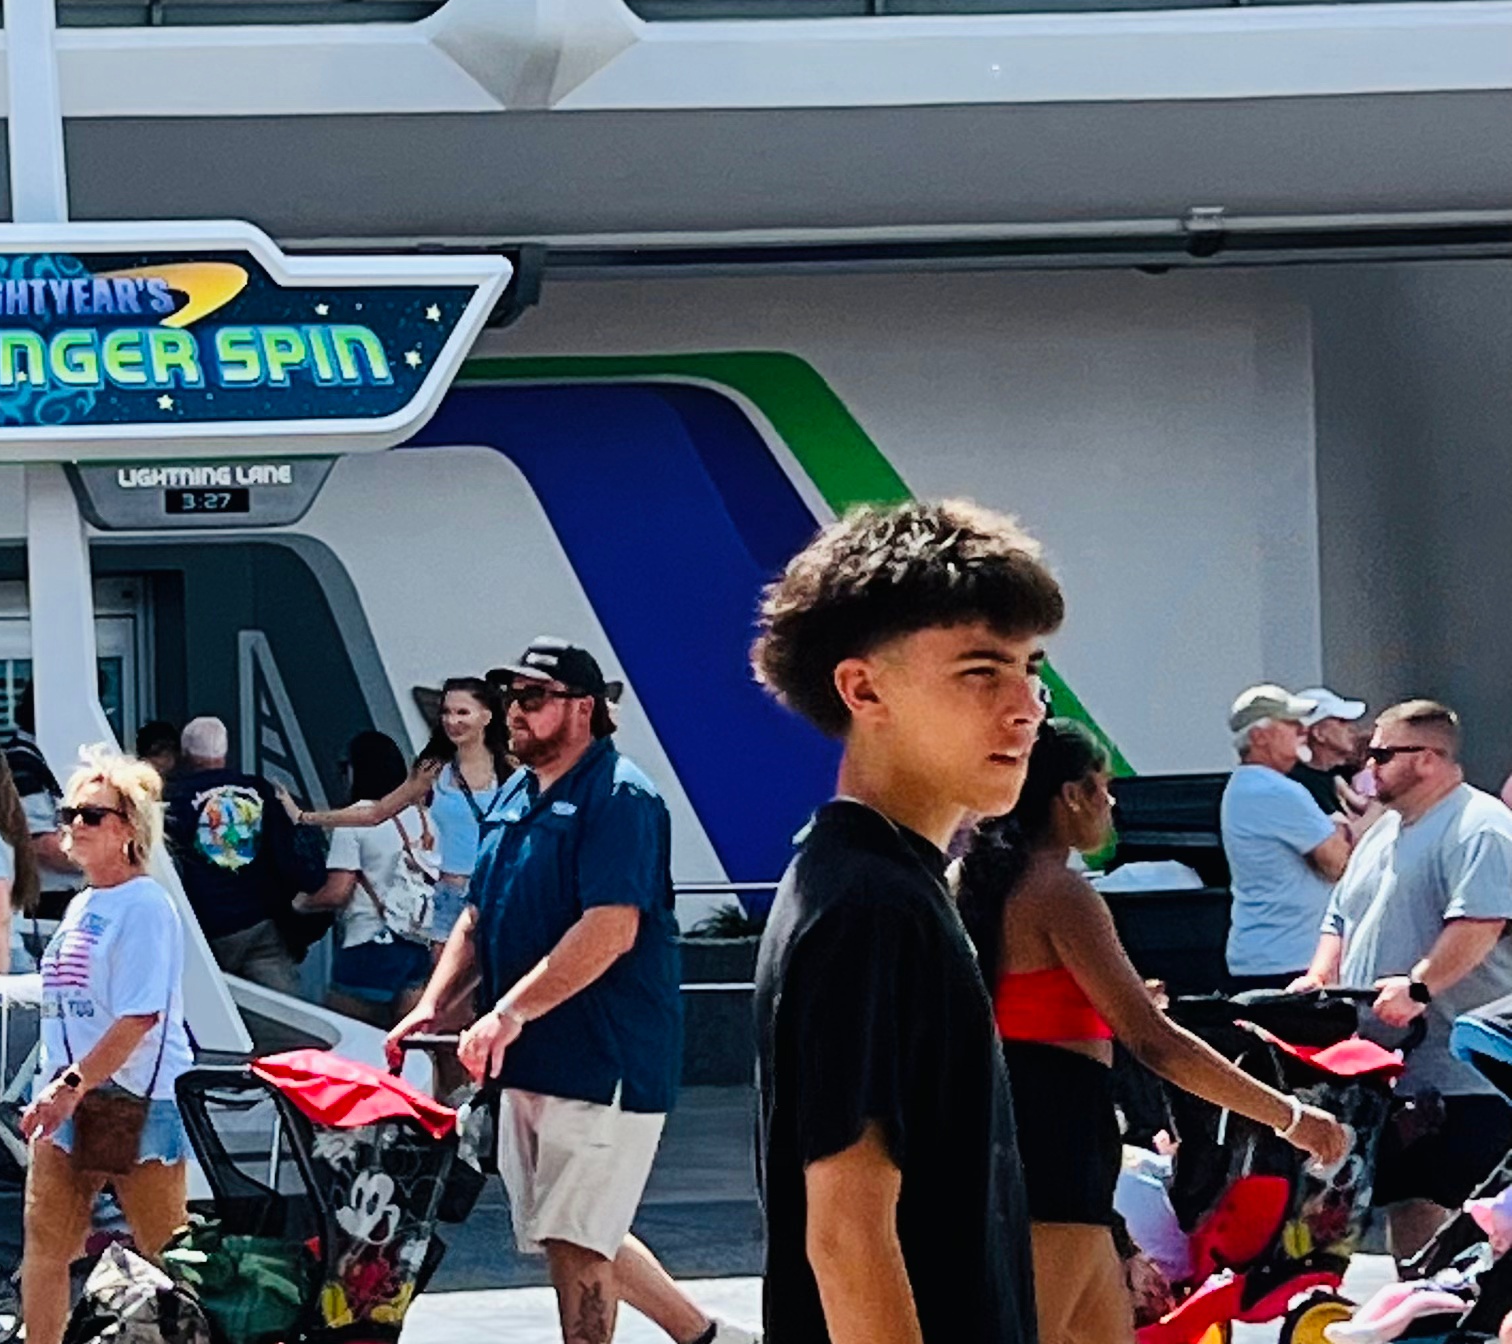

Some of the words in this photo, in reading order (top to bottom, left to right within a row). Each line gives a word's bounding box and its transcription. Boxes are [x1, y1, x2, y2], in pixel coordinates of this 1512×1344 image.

[215, 325, 394, 388] SPIN
[118, 466, 232, 488] LIGHTNING
[235, 464, 293, 485] LANE
[181, 492, 232, 510] 3:27
